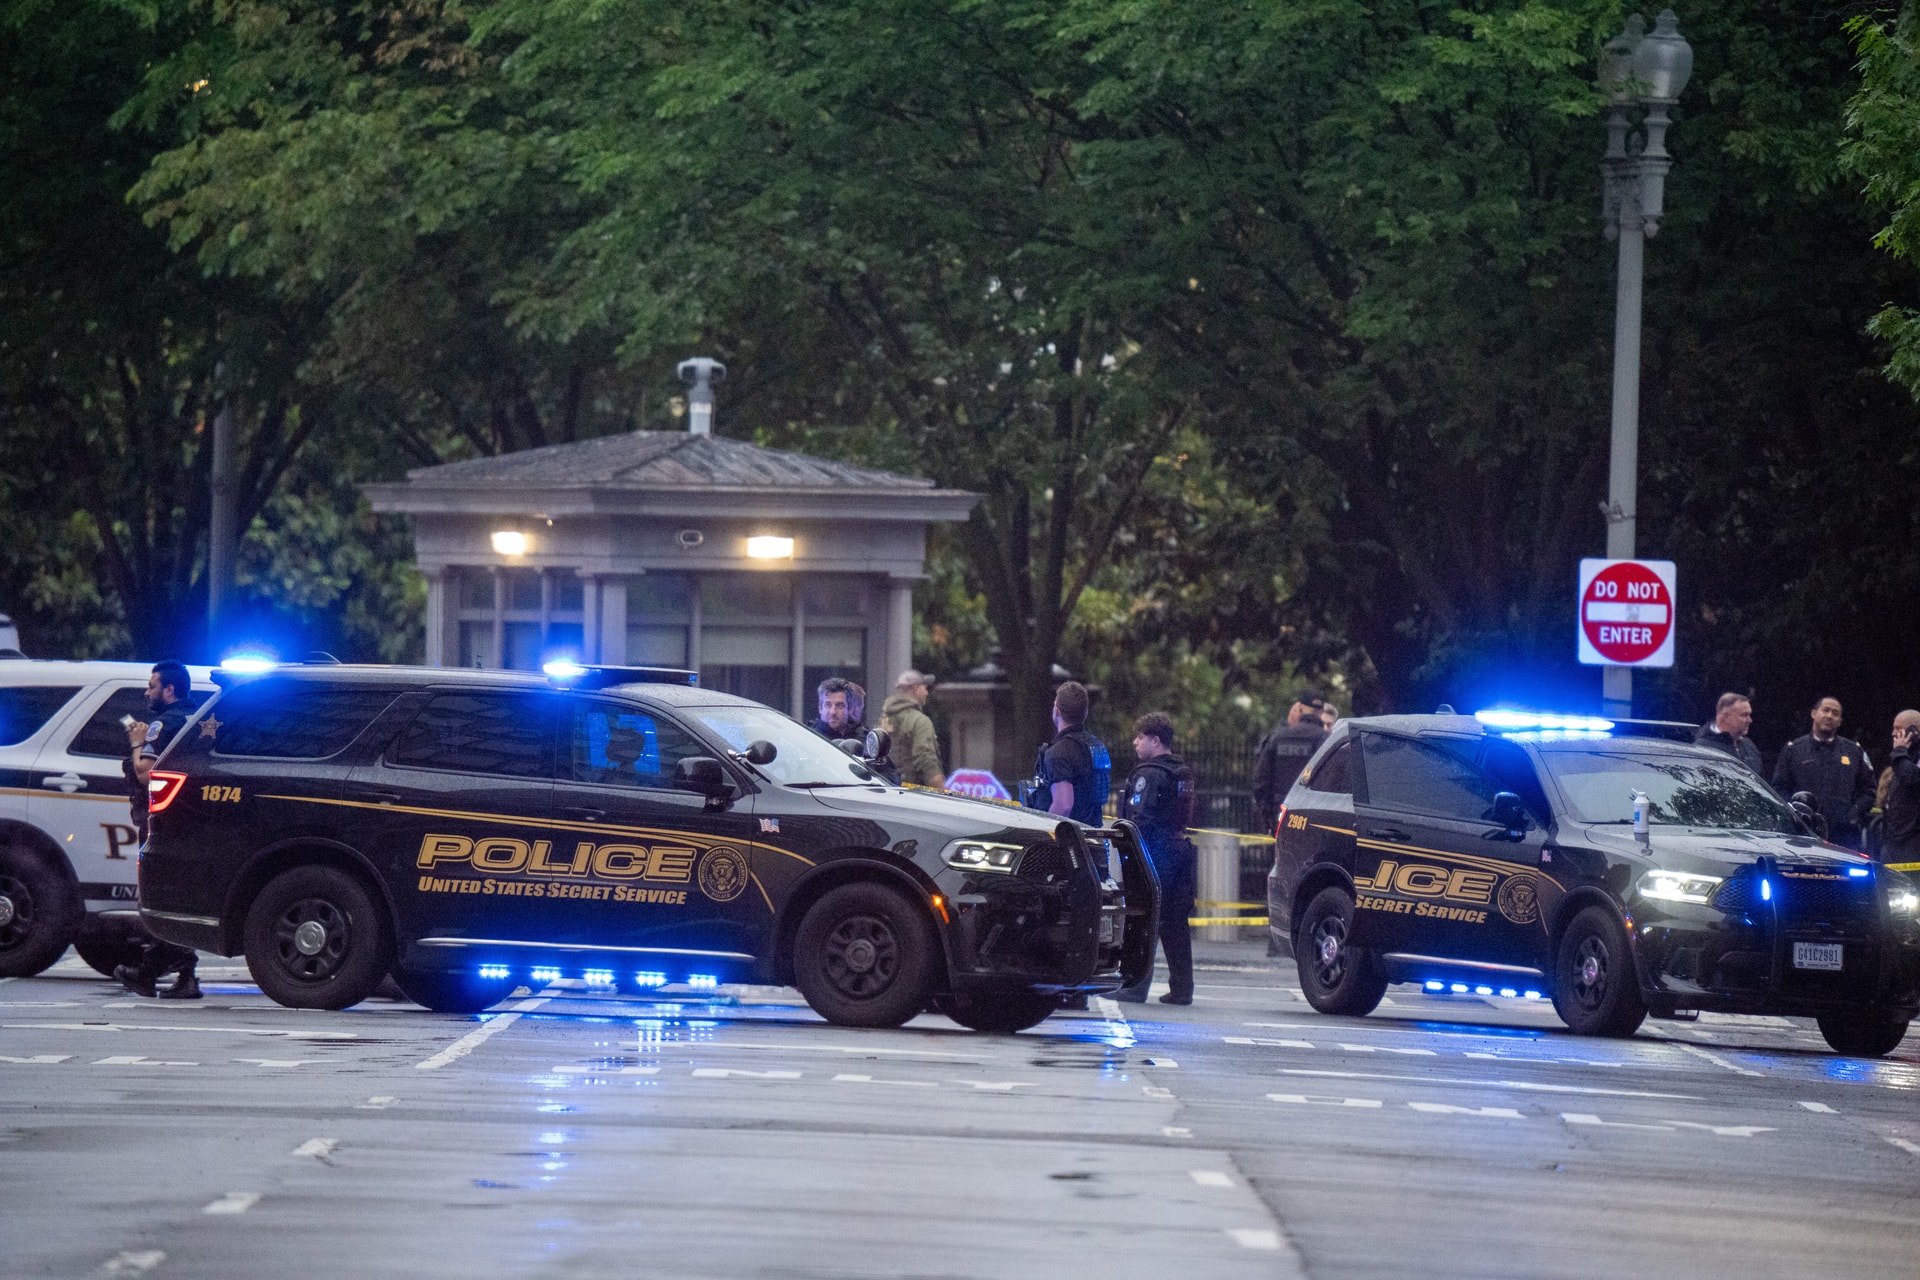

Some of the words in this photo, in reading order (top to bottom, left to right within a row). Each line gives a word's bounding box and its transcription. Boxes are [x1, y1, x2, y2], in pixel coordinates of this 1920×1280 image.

[1595, 581, 1618, 598] DO
[1627, 582, 1660, 600] NOT
[1600, 626, 1653, 645] ENTER
[201, 785, 242, 803] 1874
[1287, 814, 1308, 831] 2981
[416, 834, 697, 883] POLICE
[418, 876, 481, 894] UNITED
[482, 878, 545, 897] STATES
[546, 881, 613, 900] SECRET
[613, 886, 687, 904] SERVICE
[1355, 895, 1415, 914] SECRET
[1415, 902, 1488, 923] SERVICE
[1798, 947, 1838, 962] G41C2981
